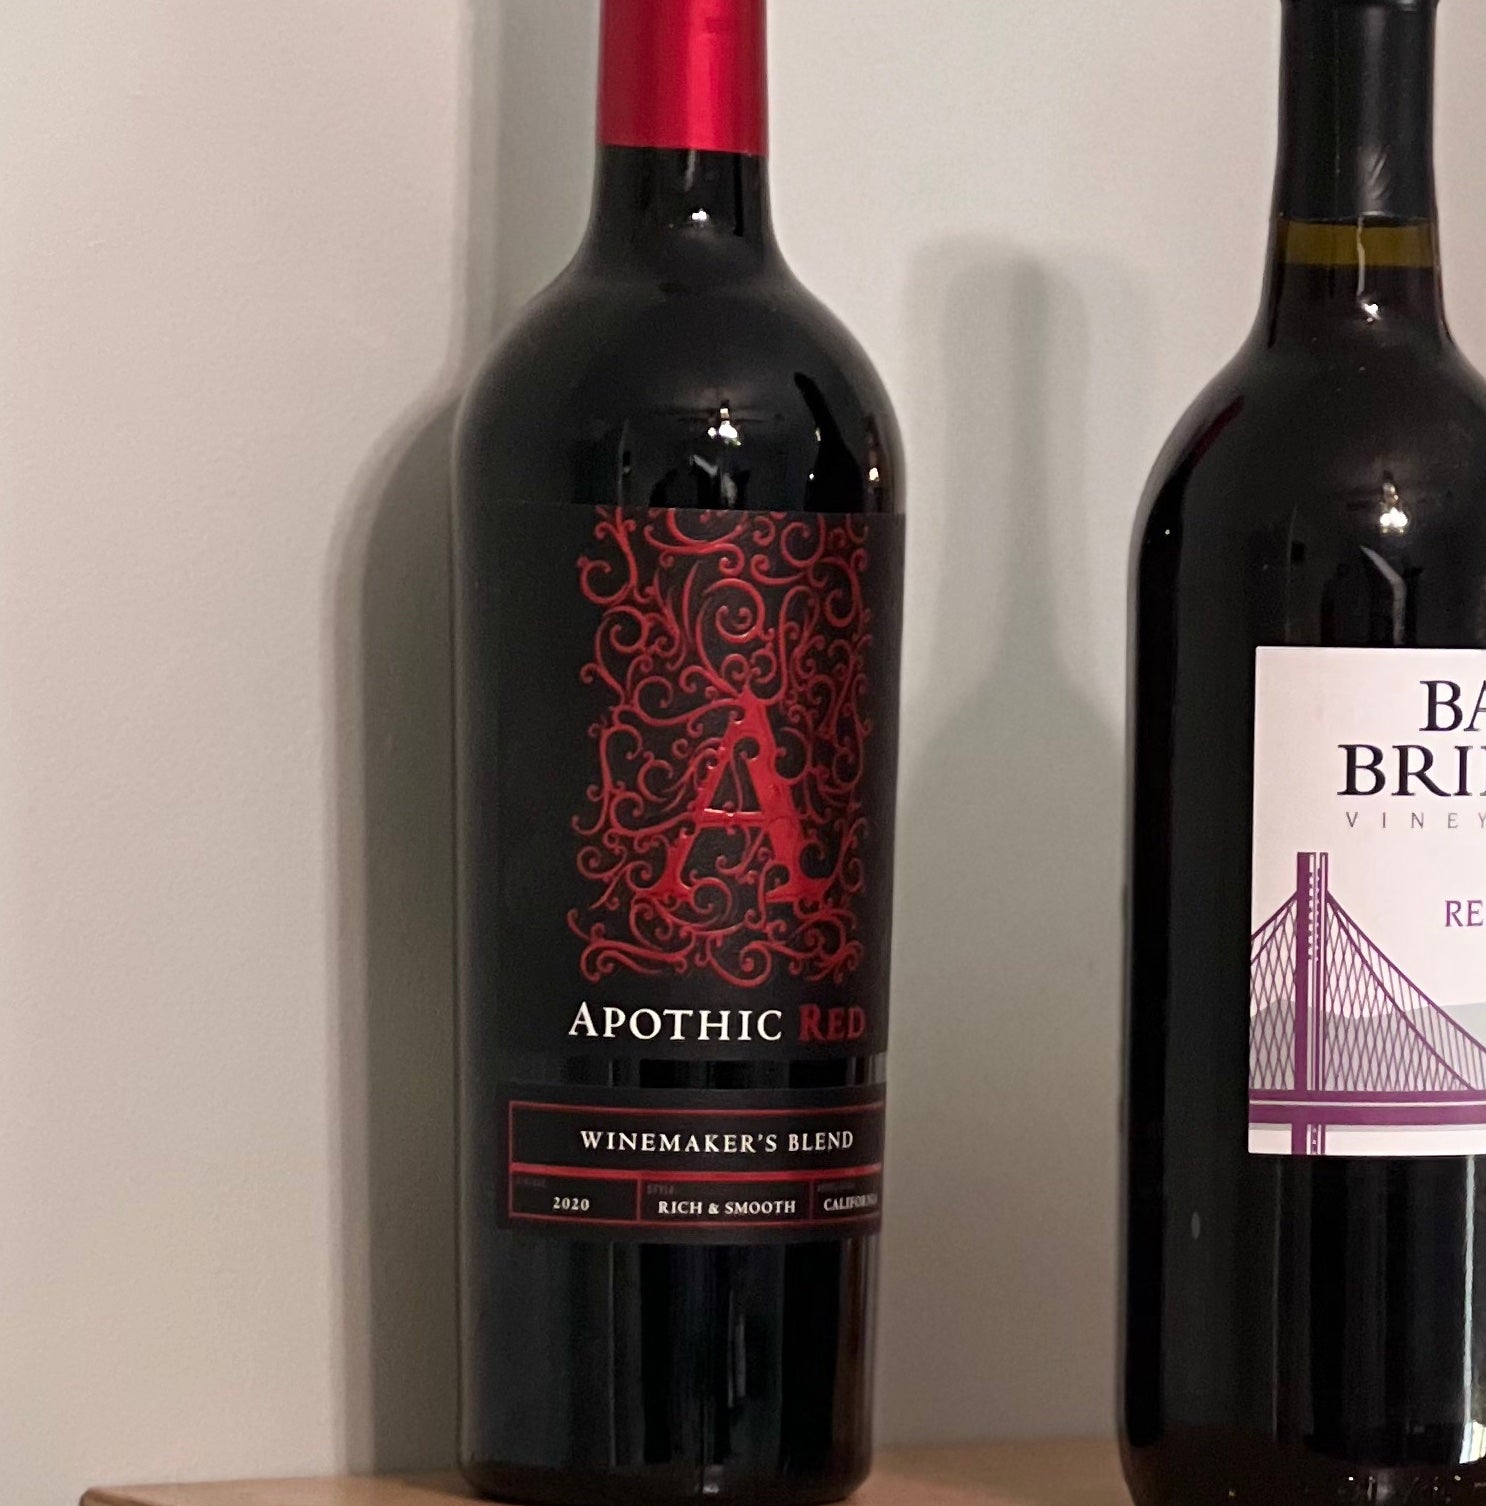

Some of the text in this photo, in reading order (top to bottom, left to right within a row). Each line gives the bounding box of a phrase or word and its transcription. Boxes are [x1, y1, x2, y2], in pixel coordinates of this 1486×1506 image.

[568, 1002, 866, 1041] APOTHIC RED
[580, 1130, 854, 1153] WINEMAKER'S BLEND
[553, 1196, 590, 1212] 2020
[658, 1199, 797, 1216] RICH & SMOOTH
